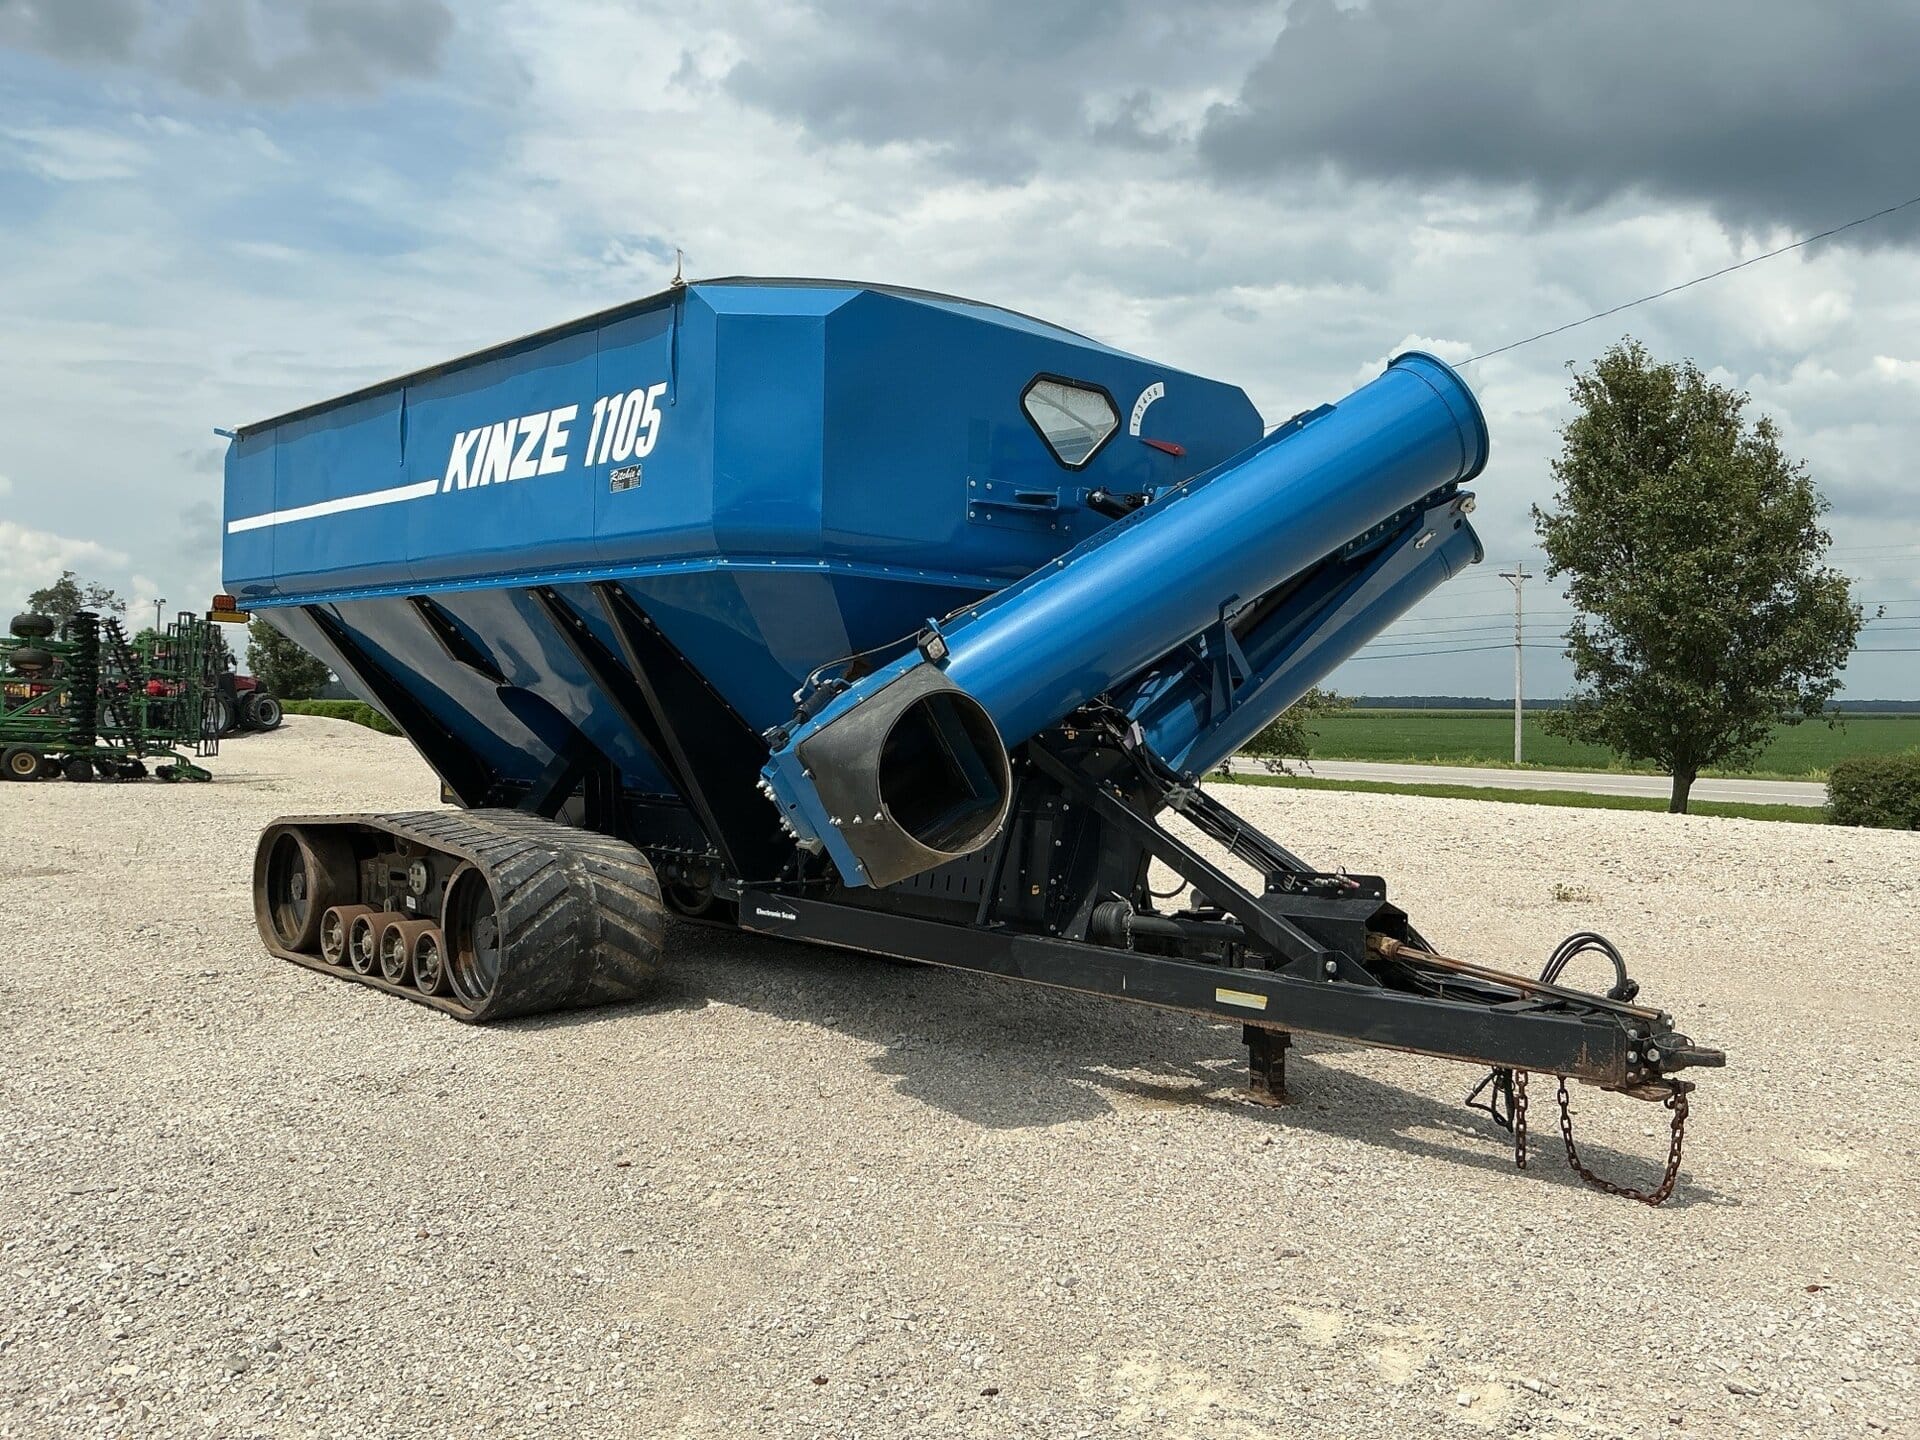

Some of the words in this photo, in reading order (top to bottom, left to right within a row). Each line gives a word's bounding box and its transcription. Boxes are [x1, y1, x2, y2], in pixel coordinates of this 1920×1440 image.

[442, 404, 578, 493] KINZE
[584, 381, 667, 467] 1105
[756, 908, 781, 917] Electronic
[782, 911, 796, 920] Scale
